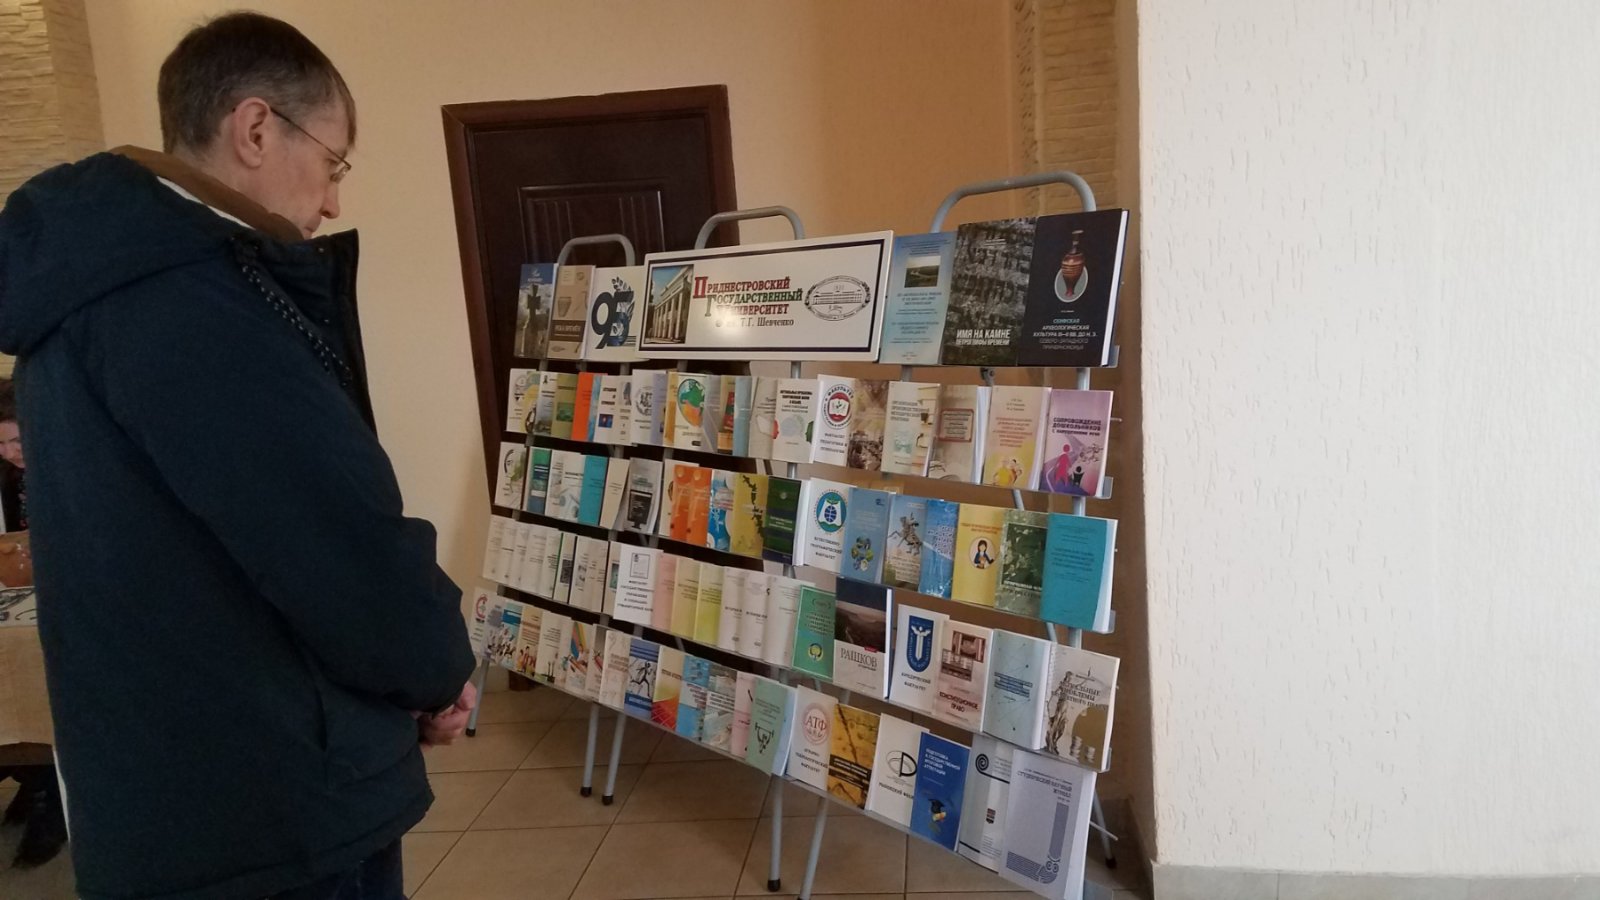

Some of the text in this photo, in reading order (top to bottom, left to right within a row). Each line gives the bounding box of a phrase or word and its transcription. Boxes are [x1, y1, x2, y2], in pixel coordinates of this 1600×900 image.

[692, 276, 790, 299] ПРИДНЕСТРОВСКИЙ
[705, 288, 803, 317] ГОСУДАРСТВЕННЫЙ
[716, 304, 789, 316] ИВЕРСИТЕТ
[757, 317, 794, 327] Шевченко
[956, 329, 1011, 338] ИМЯ НА КАМНЕ
[1052, 422, 1101, 431] ДОШКОЛЬНИКОВ
[1053, 417, 1101, 425] СОПРОВОЖДЕНИЕ
[840, 647, 878, 668] РАШКОВ
[804, 715, 827, 731] АТФ
